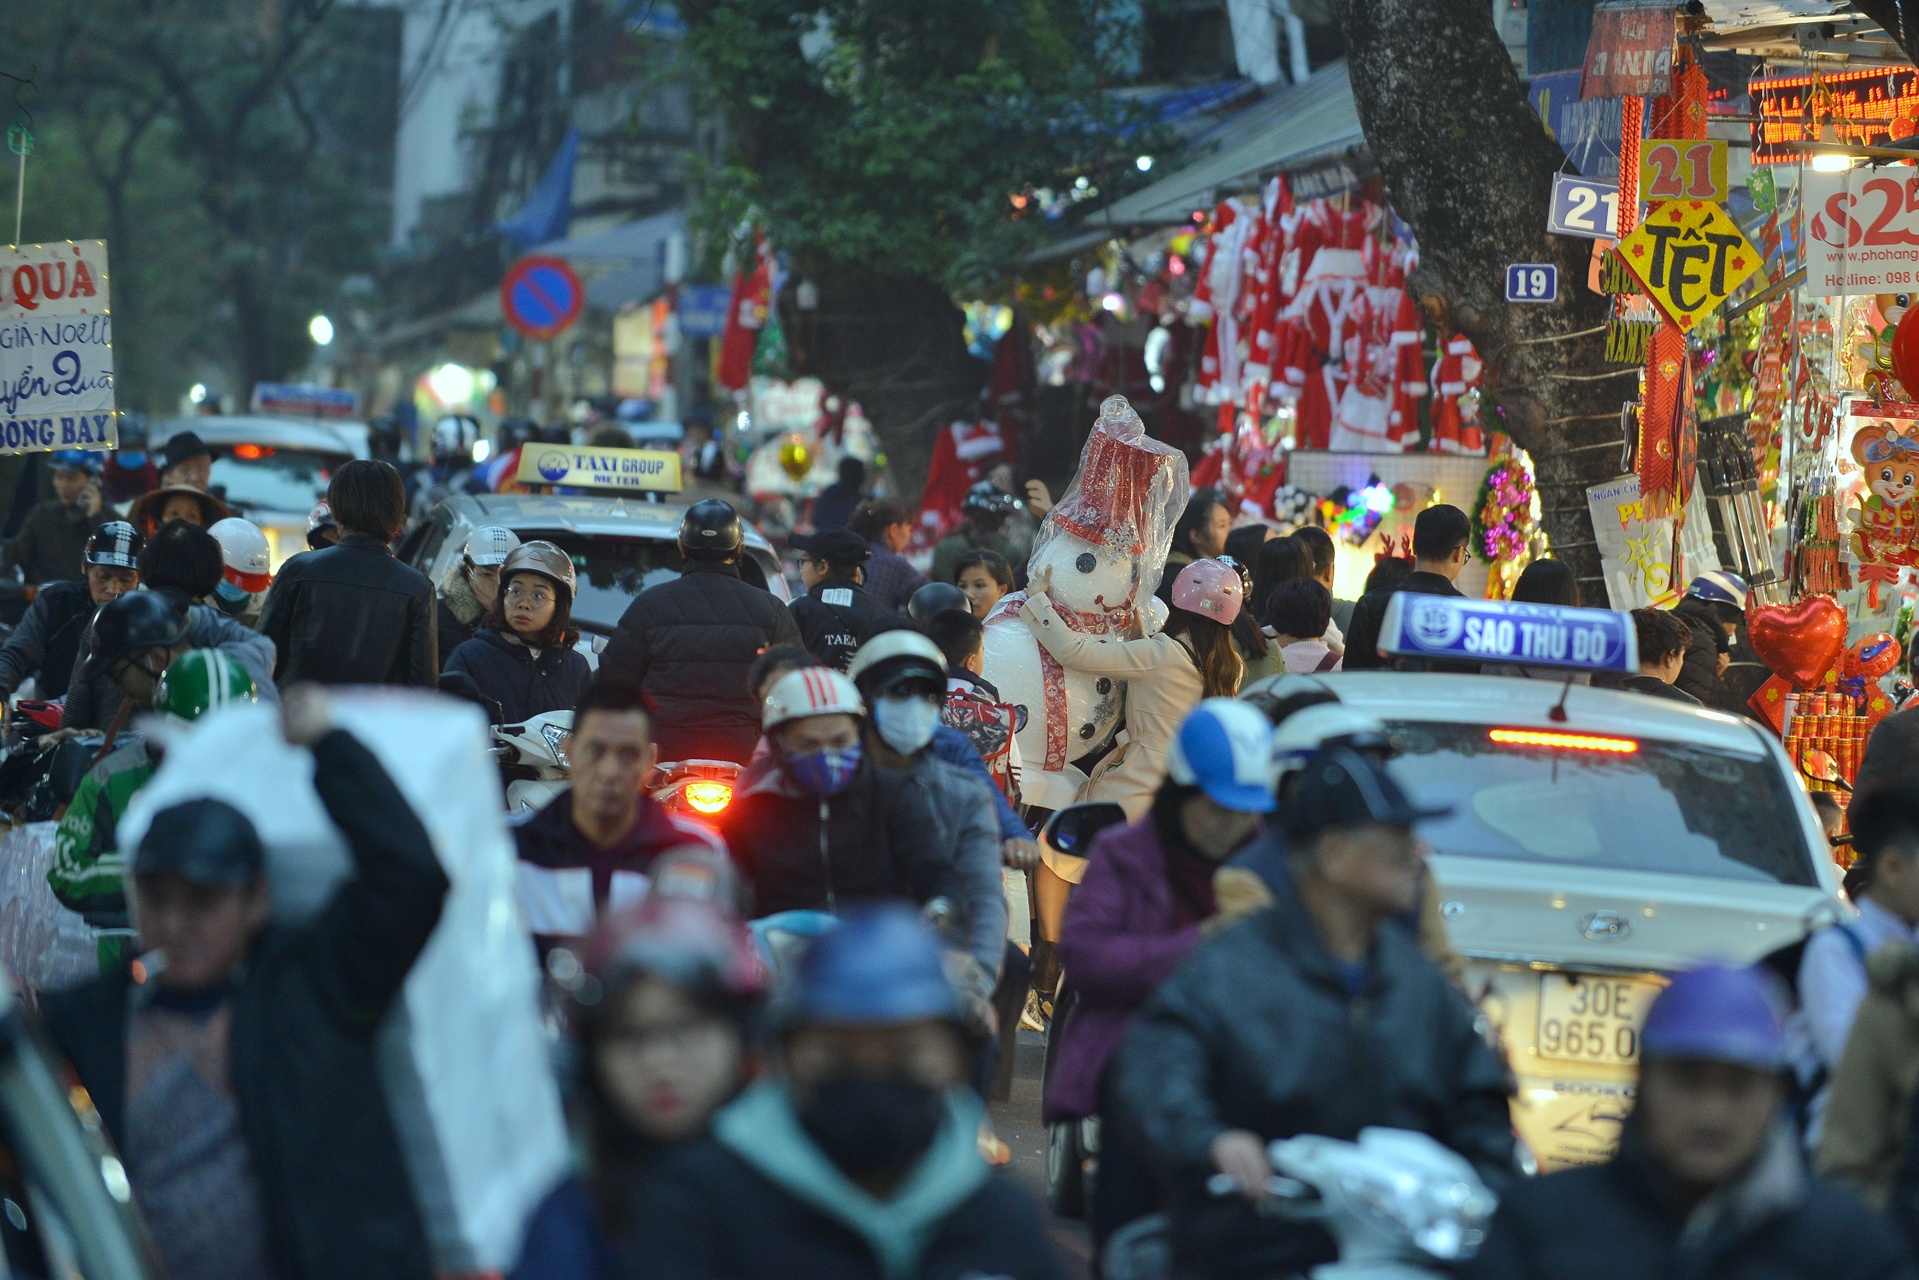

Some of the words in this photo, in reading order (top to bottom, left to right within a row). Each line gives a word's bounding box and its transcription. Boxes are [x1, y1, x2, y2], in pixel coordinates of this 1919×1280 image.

[1646, 144, 1718, 199] 21
[1564, 186, 1618, 233] 21
[1645, 212, 1742, 312] TẾT
[1886, 271, 1911, 284] 098
[1516, 270, 1546, 297] 19
[61, 414, 109, 445] BAY
[573, 454, 617, 472] TAXI
[622, 459, 664, 475] GROUP
[594, 475, 639, 486] METER
[1463, 616, 1515, 655] SAO
[1570, 980, 1632, 1020] 30E
[1545, 1018, 1636, 1059] 965.0
